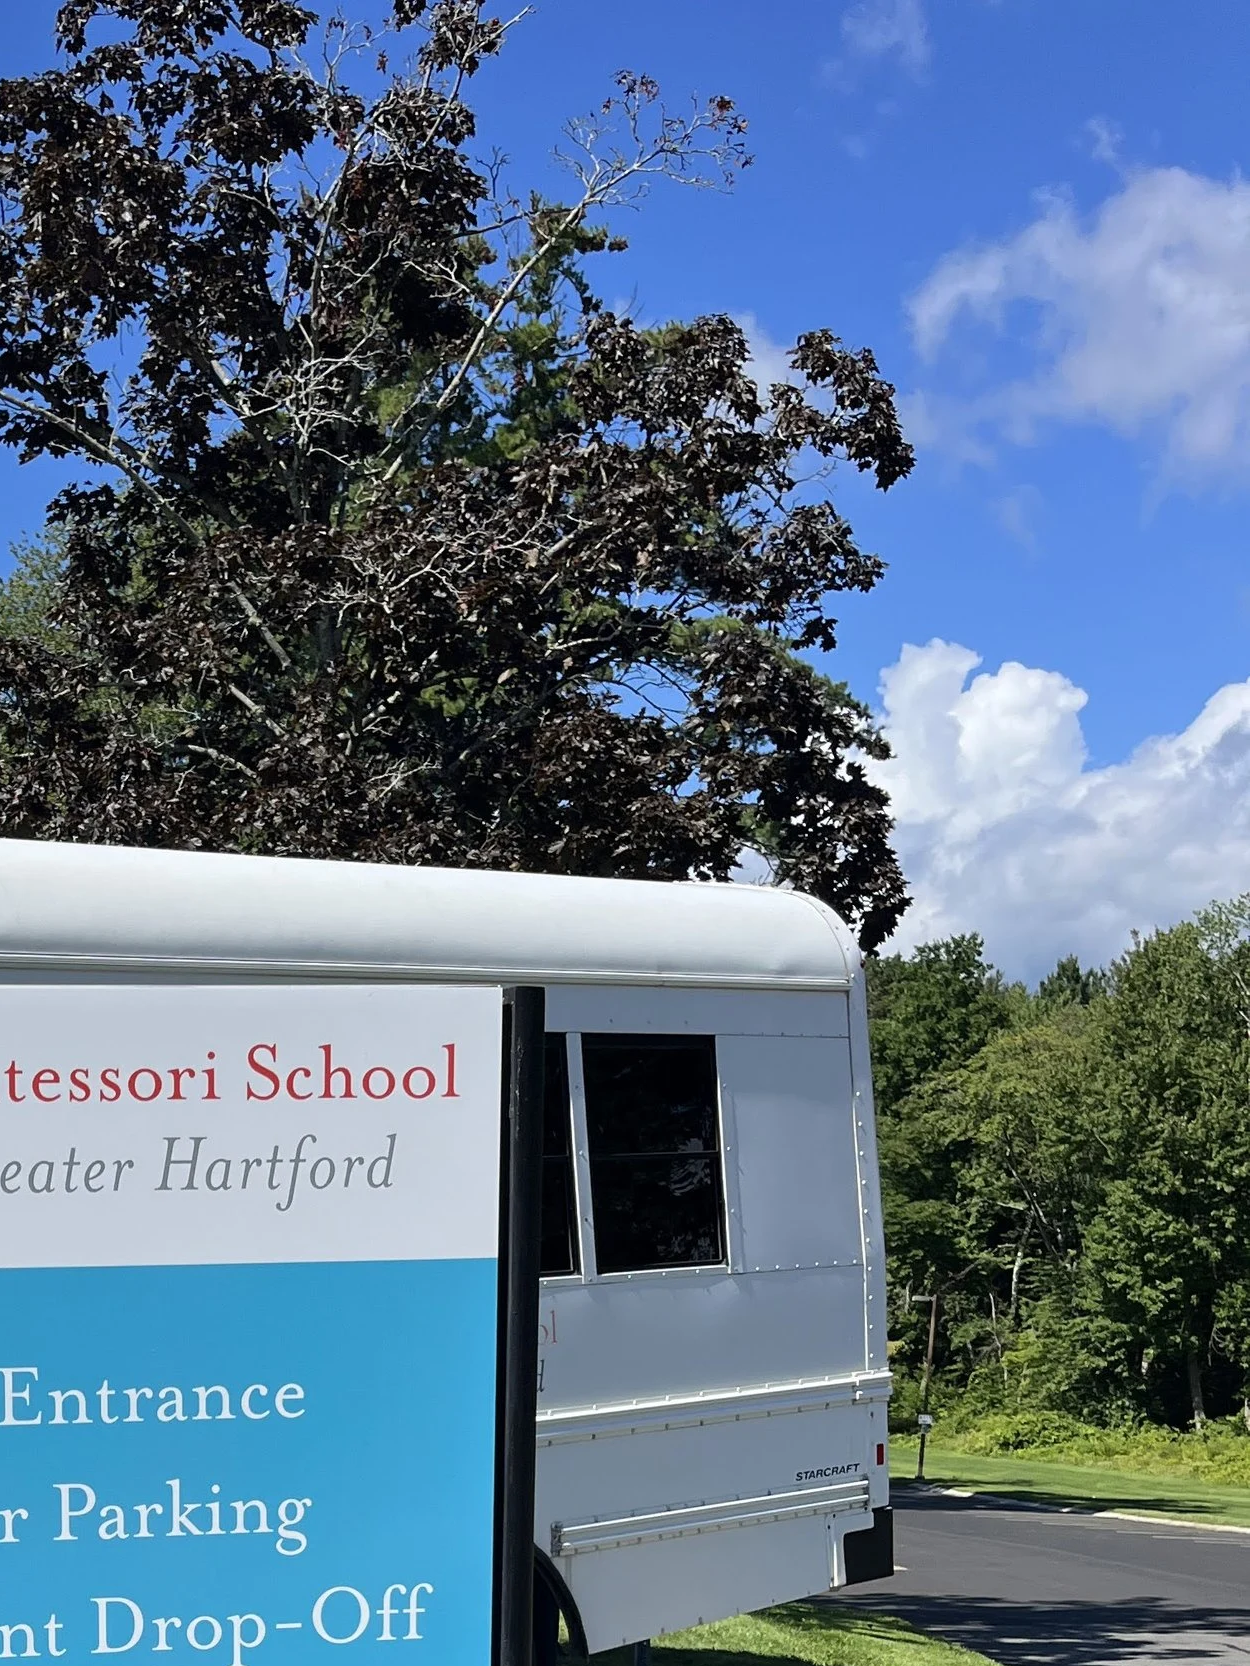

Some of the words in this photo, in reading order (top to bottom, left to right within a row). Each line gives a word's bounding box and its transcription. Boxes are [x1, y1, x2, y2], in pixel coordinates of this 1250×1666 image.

[246, 1043, 460, 1102] School
[153, 1132, 399, 1213] Hartford
[795, 1463, 860, 1481] STARCRAFT
[53, 1478, 313, 1556] Parking
